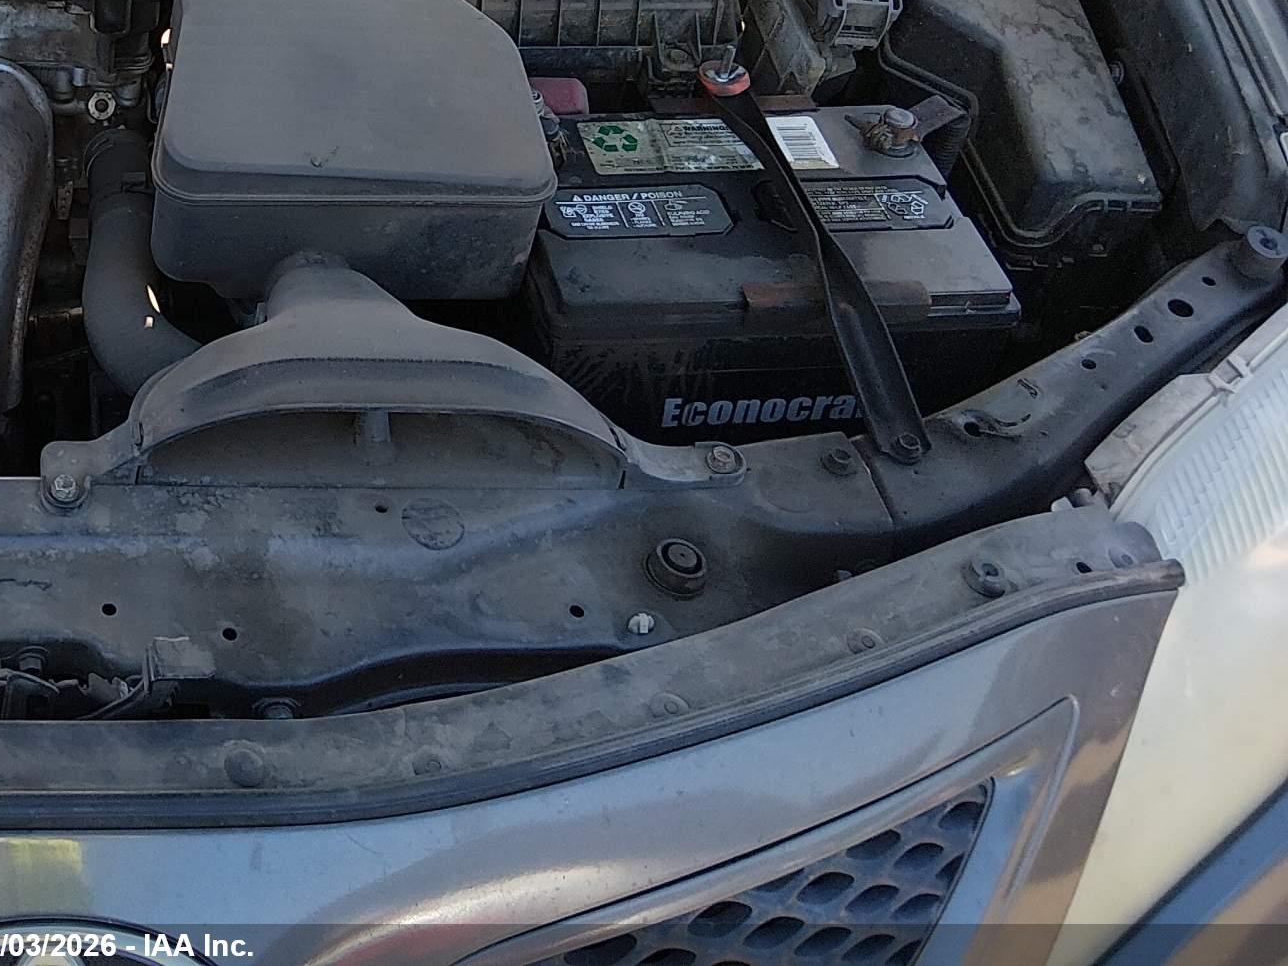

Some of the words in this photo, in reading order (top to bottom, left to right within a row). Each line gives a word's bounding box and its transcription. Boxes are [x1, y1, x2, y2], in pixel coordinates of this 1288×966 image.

[583, 193, 630, 202] DANGER
[640, 190, 683, 199] POISON
[661, 394, 863, 428] Econocra
